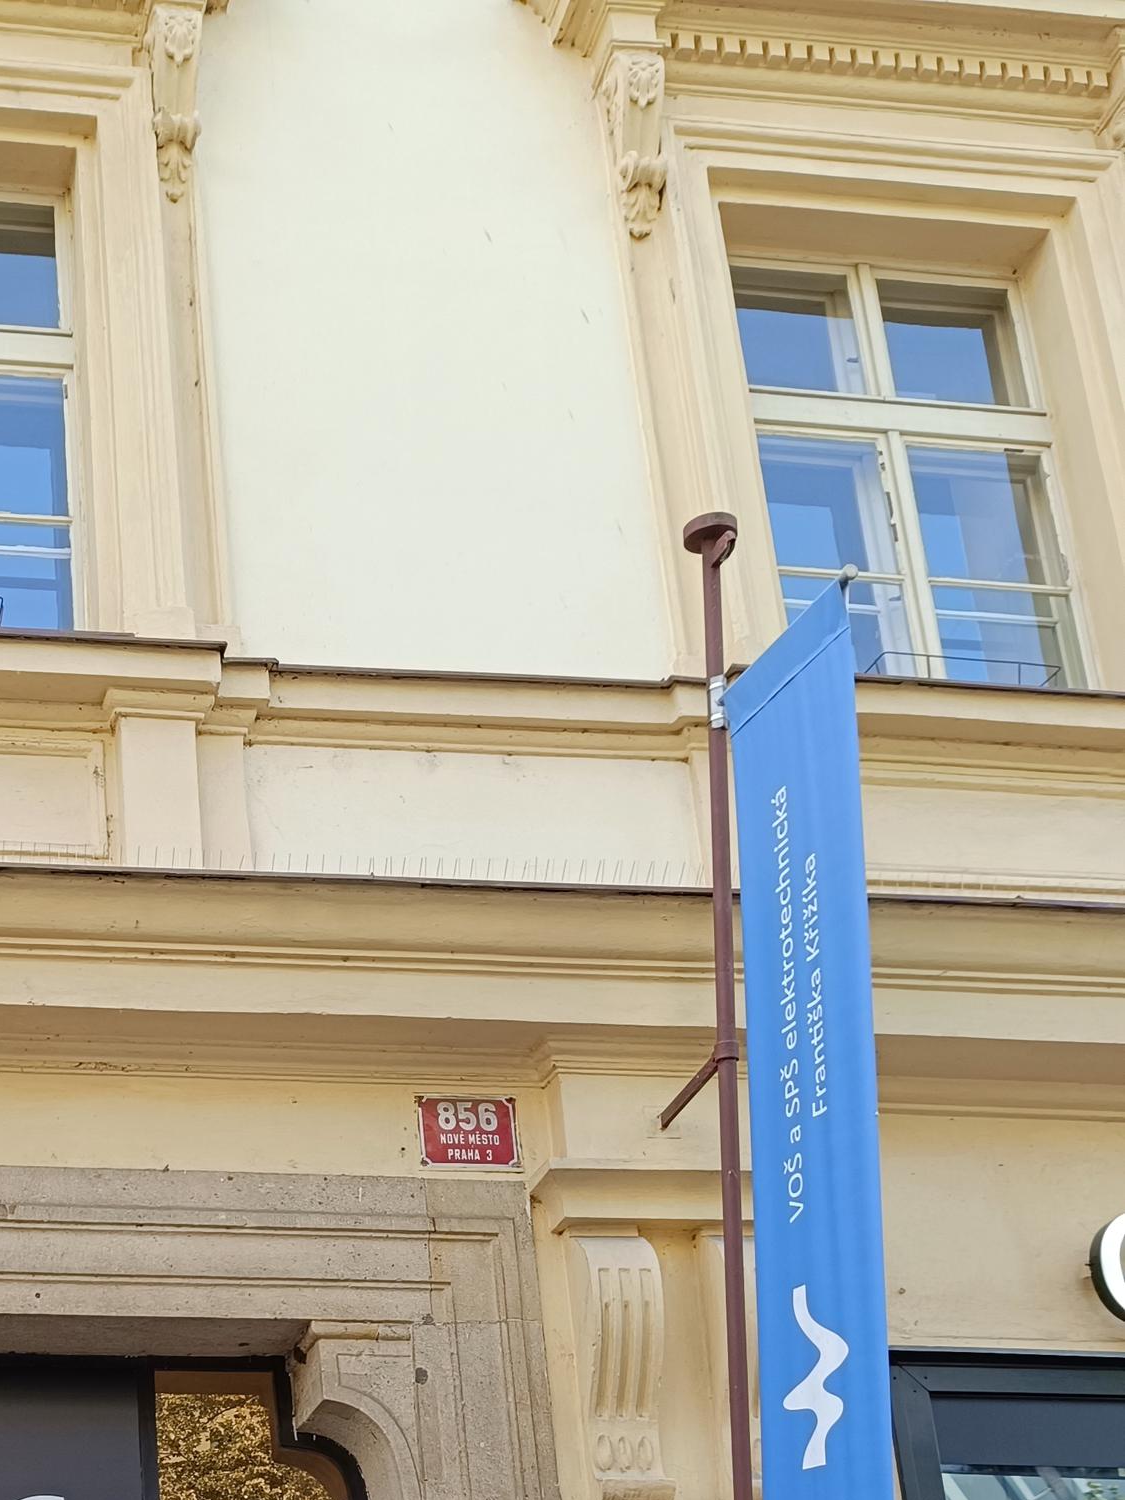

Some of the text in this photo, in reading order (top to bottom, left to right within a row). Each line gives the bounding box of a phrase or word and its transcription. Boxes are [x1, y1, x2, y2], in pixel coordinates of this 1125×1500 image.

[771, 785, 804, 1223] VOŠ a SPŠ elektrotechnická
[806, 967, 828, 1118] Františka
[436, 1101, 498, 1131] 856
[440, 1131, 500, 1146] NOVÉ MĚSTO
[447, 1148, 493, 1160] PRAHA 3
